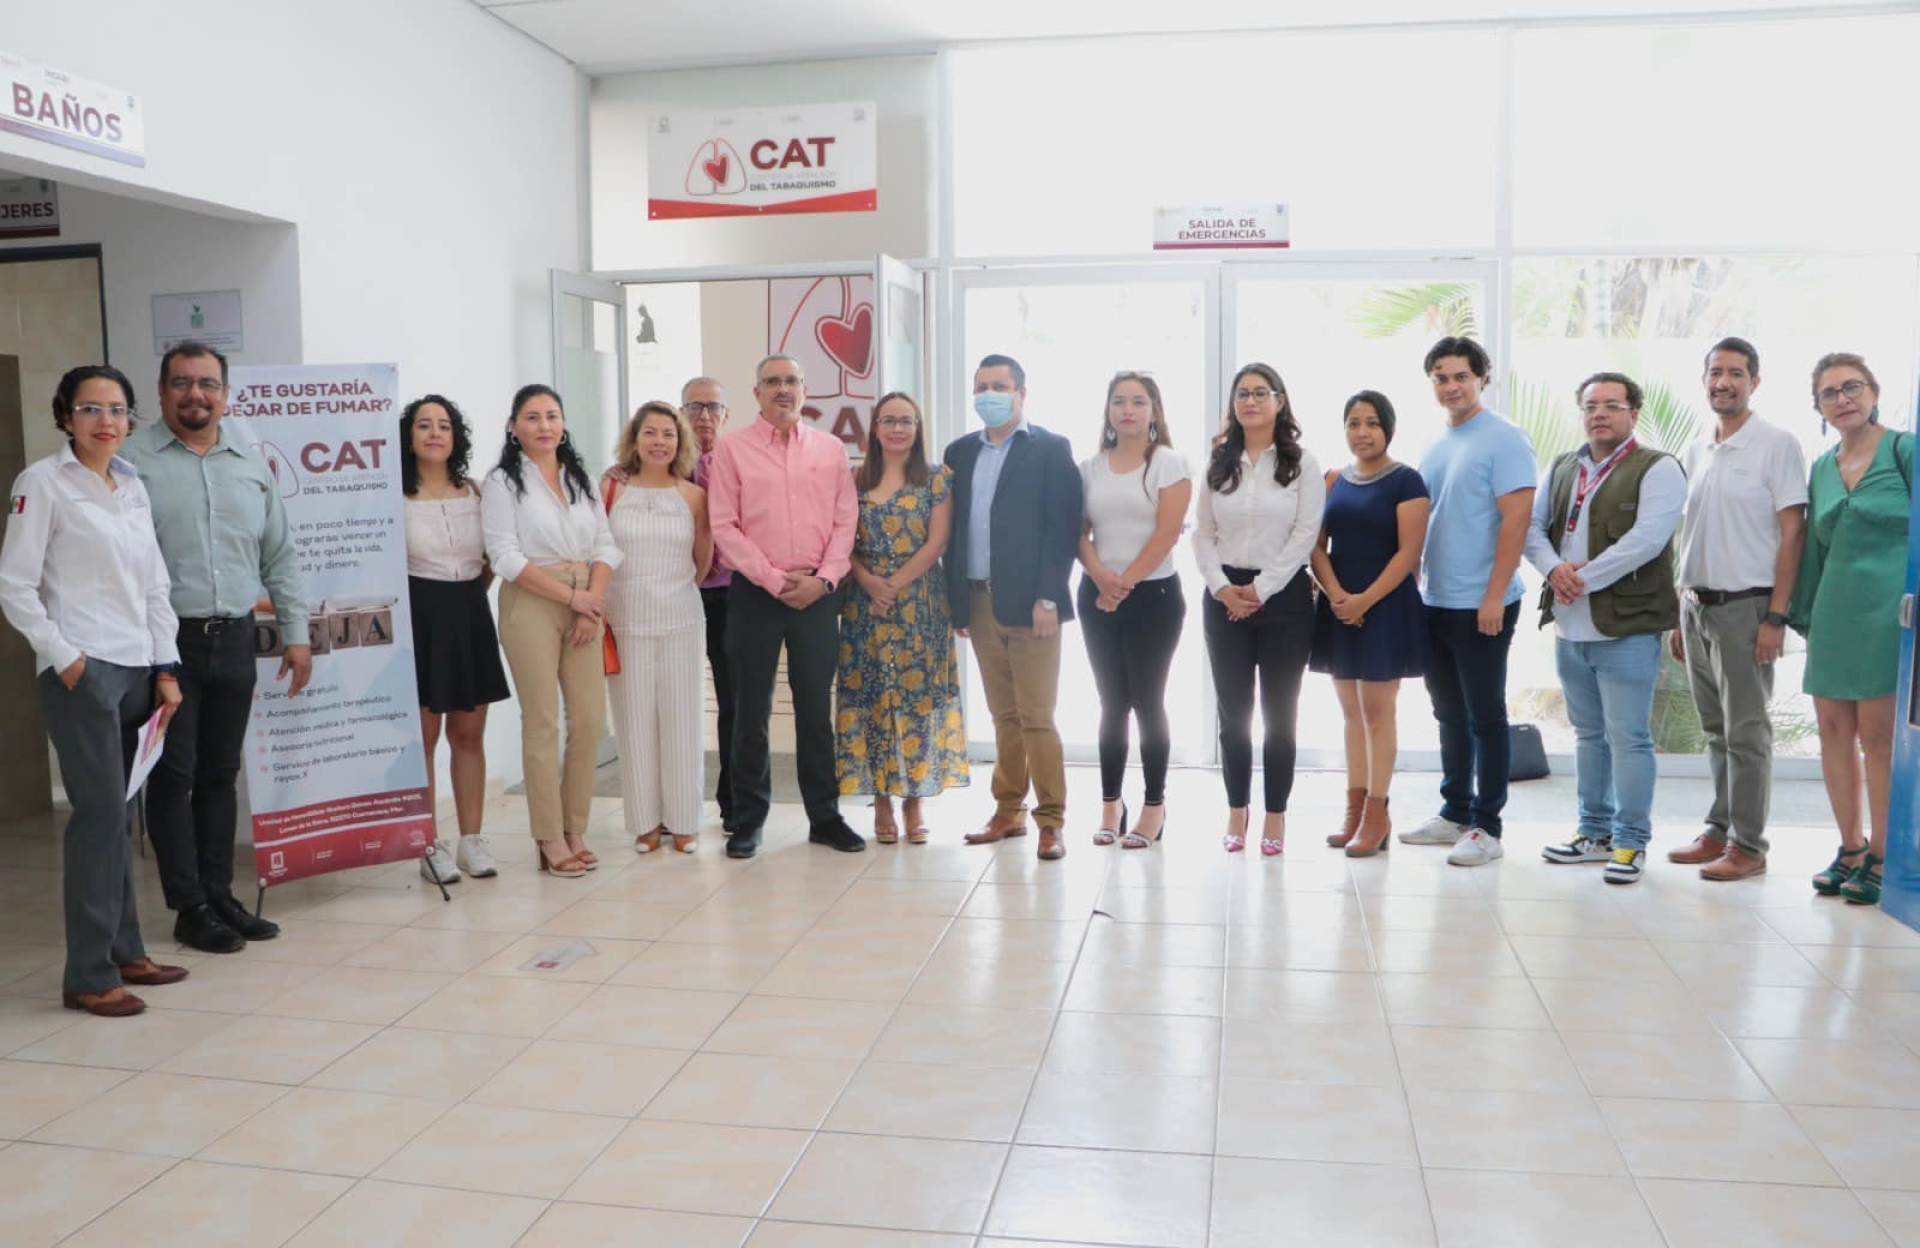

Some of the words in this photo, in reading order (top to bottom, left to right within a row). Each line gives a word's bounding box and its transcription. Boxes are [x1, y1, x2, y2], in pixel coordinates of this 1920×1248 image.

[12, 81, 122, 142] BAÑOS
[750, 137, 836, 170] CAT
[750, 183, 768, 192] DEL
[771, 180, 836, 190] TABAQUISMO
[1, 202, 55, 219] JERES
[1188, 219, 1235, 229] SALIDA
[1239, 218, 1256, 228] DE
[1178, 229, 1266, 240] EMERGENCIAS
[237, 384, 273, 402] ¿TE
[276, 379, 373, 398] GUSTARÍA
[221, 403, 282, 418] DEJAR
[287, 402, 312, 415] DE
[316, 398, 393, 415] FUMAR?
[300, 438, 387, 474] CAT
[303, 486, 325, 495] DEL
[326, 482, 388, 493] TABAQUISMO
[316, 520, 343, 532] poco
[295, 533, 339, 547] ograrás
[254, 613, 388, 653] DEJA
